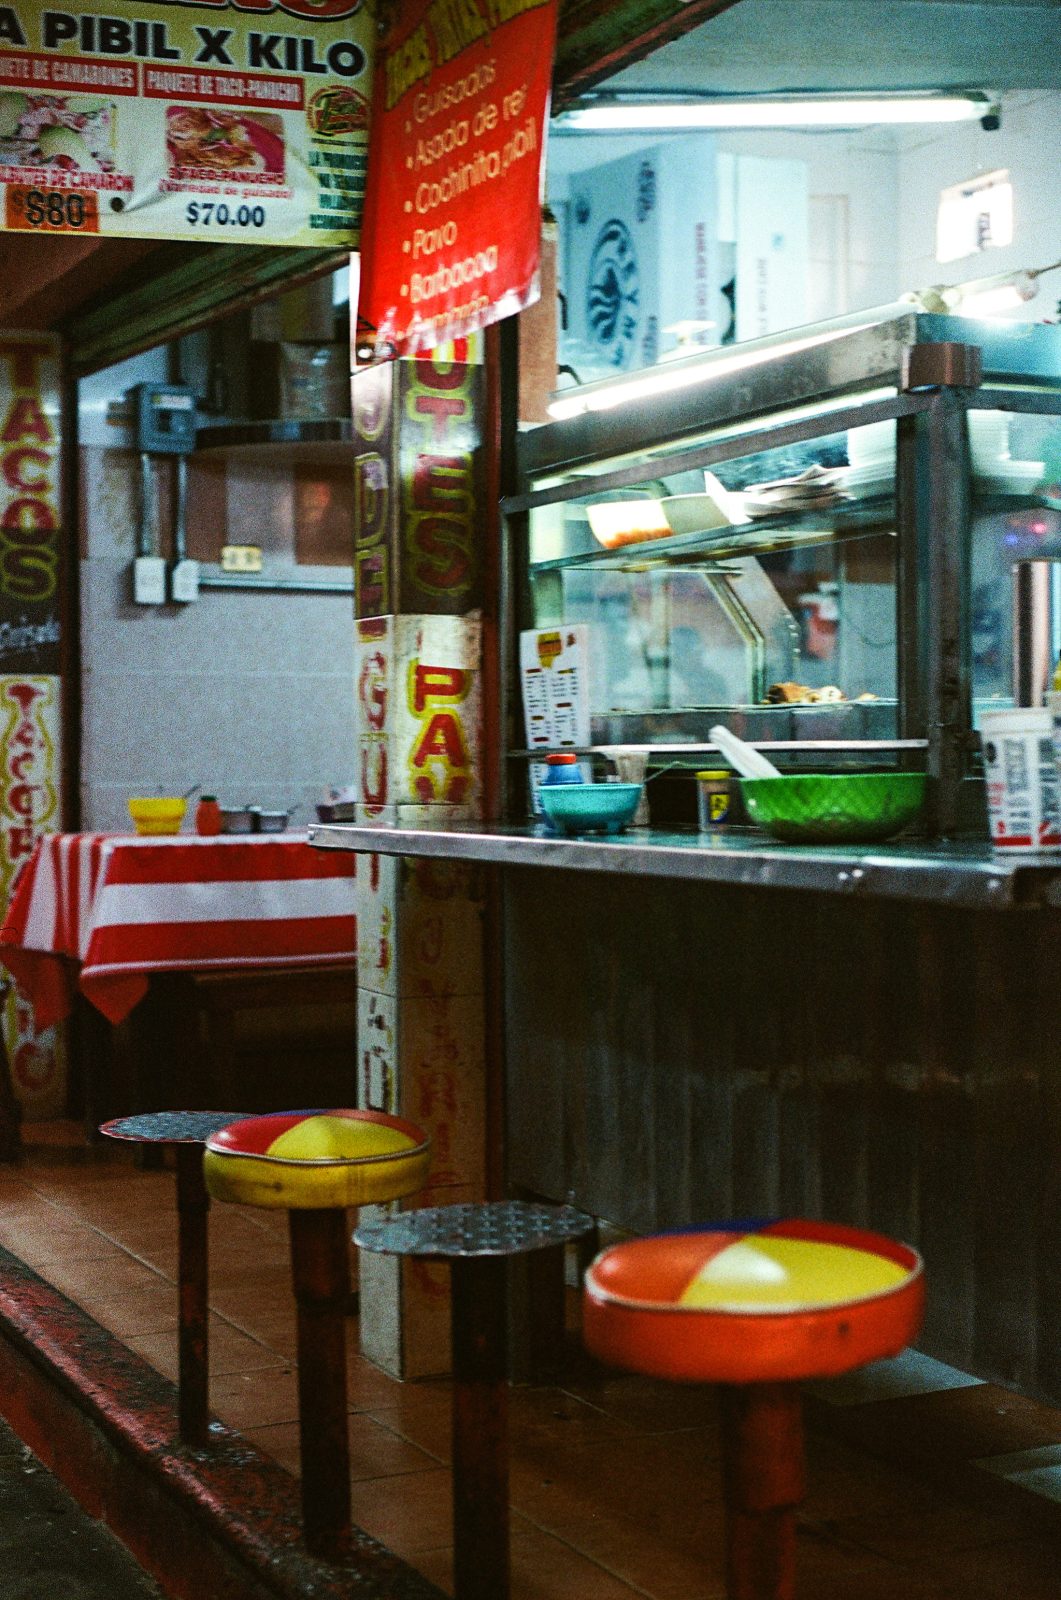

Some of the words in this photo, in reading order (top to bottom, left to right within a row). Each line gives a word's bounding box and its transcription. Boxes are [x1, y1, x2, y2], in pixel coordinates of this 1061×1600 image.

[43, 12, 181, 60] PIBIL
[194, 27, 234, 67] X
[248, 33, 365, 78] KILO
[32, 59, 50, 81] DE
[147, 70, 197, 95] PAQUETE
[198, 75, 213, 95] DE
[473, 102, 498, 136] de
[415, 150, 501, 214] Cochinita
[25, 188, 86, 228] $80
[186, 201, 266, 228] $70.00
[412, 221, 458, 260] Pavo
[410, 244, 499, 304] Barbacoa
[0, 337, 59, 602] TACOS
[404, 335, 474, 600] UTES
